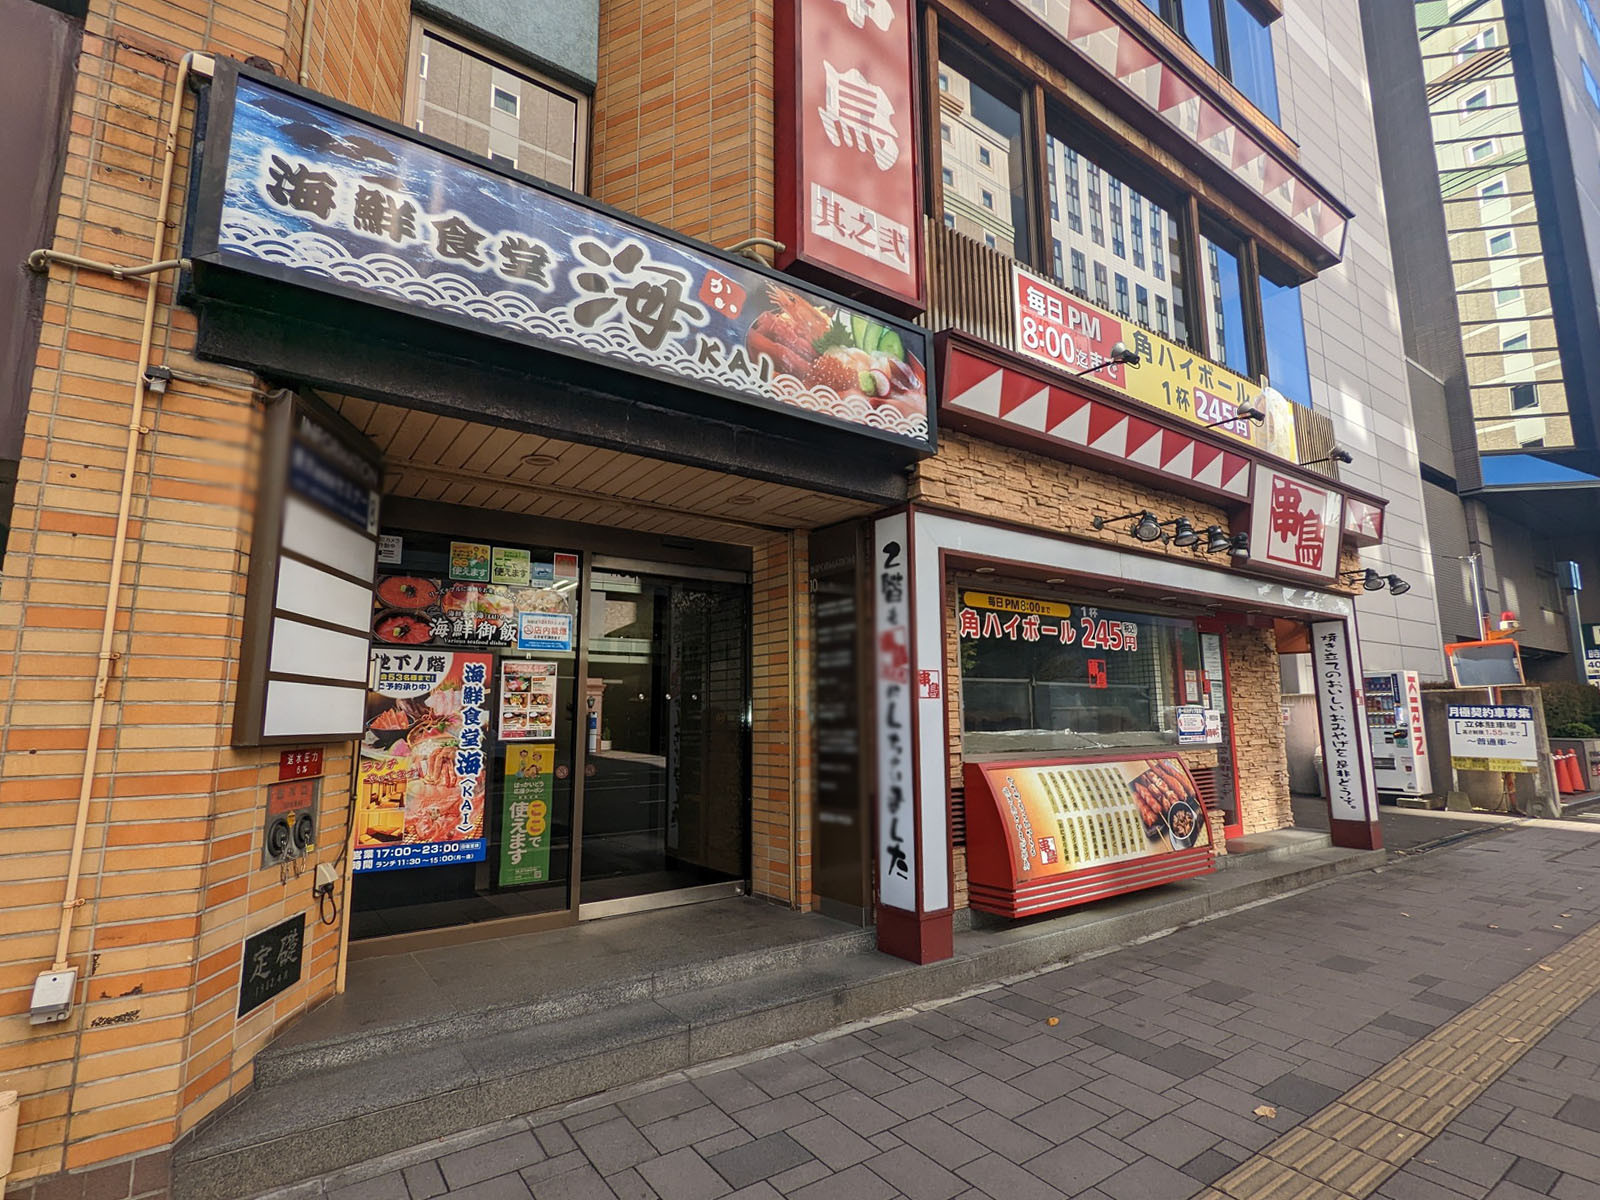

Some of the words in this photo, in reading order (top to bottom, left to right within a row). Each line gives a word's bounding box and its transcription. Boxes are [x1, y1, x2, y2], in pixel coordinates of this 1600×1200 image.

[262, 151, 553, 292] 海鮮食堂
[572, 240, 705, 351] 海
[816, 194, 906, 264] 其之弐
[699, 337, 770, 383] KAI
[1132, 329, 1252, 404] 角ハイボール
[1269, 477, 1325, 570] 串鳥
[494, 566, 528, 578] 使えます
[444, 637, 466, 645] Various
[959, 607, 1077, 645] 角ハイボール
[1080, 606, 1099, 619] 1杯
[1406, 676, 1426, 756] KIRIN
[1448, 706, 1532, 720] 月極契約車募集
[508, 802, 529, 865] 使えます
[248, 927, 300, 984] 定礎
